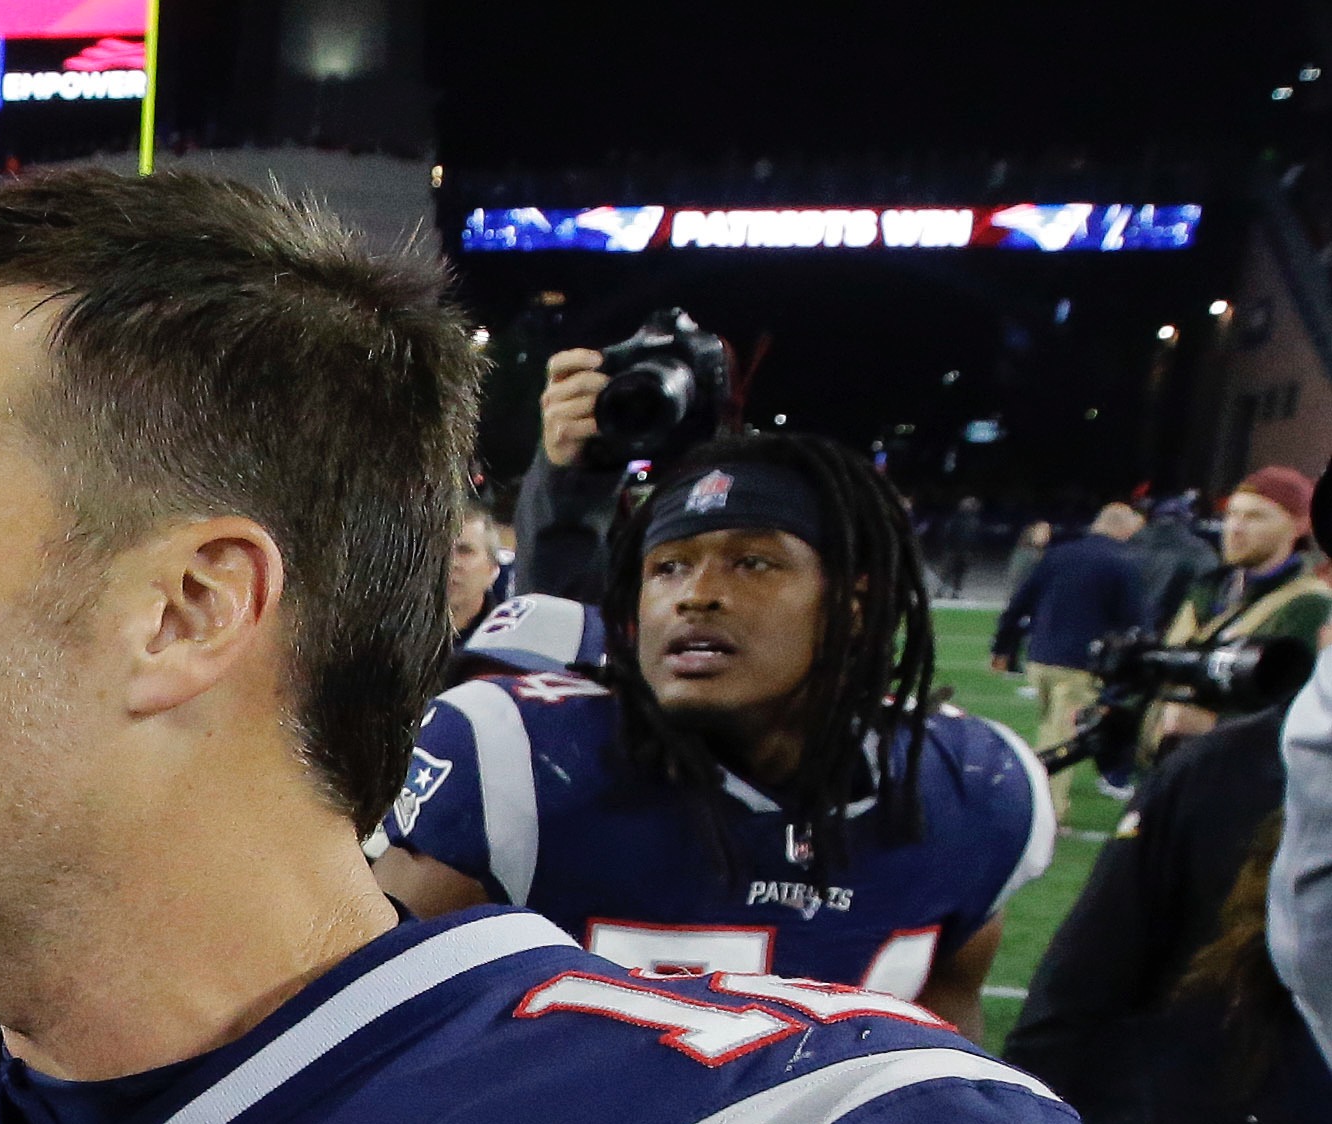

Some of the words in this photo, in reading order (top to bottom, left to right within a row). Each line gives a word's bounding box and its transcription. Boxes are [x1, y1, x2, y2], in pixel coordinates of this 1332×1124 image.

[2, 70, 147, 101] EMPOWER
[671, 209, 878, 248] PATRIOTS
[881, 208, 973, 248] WIN
